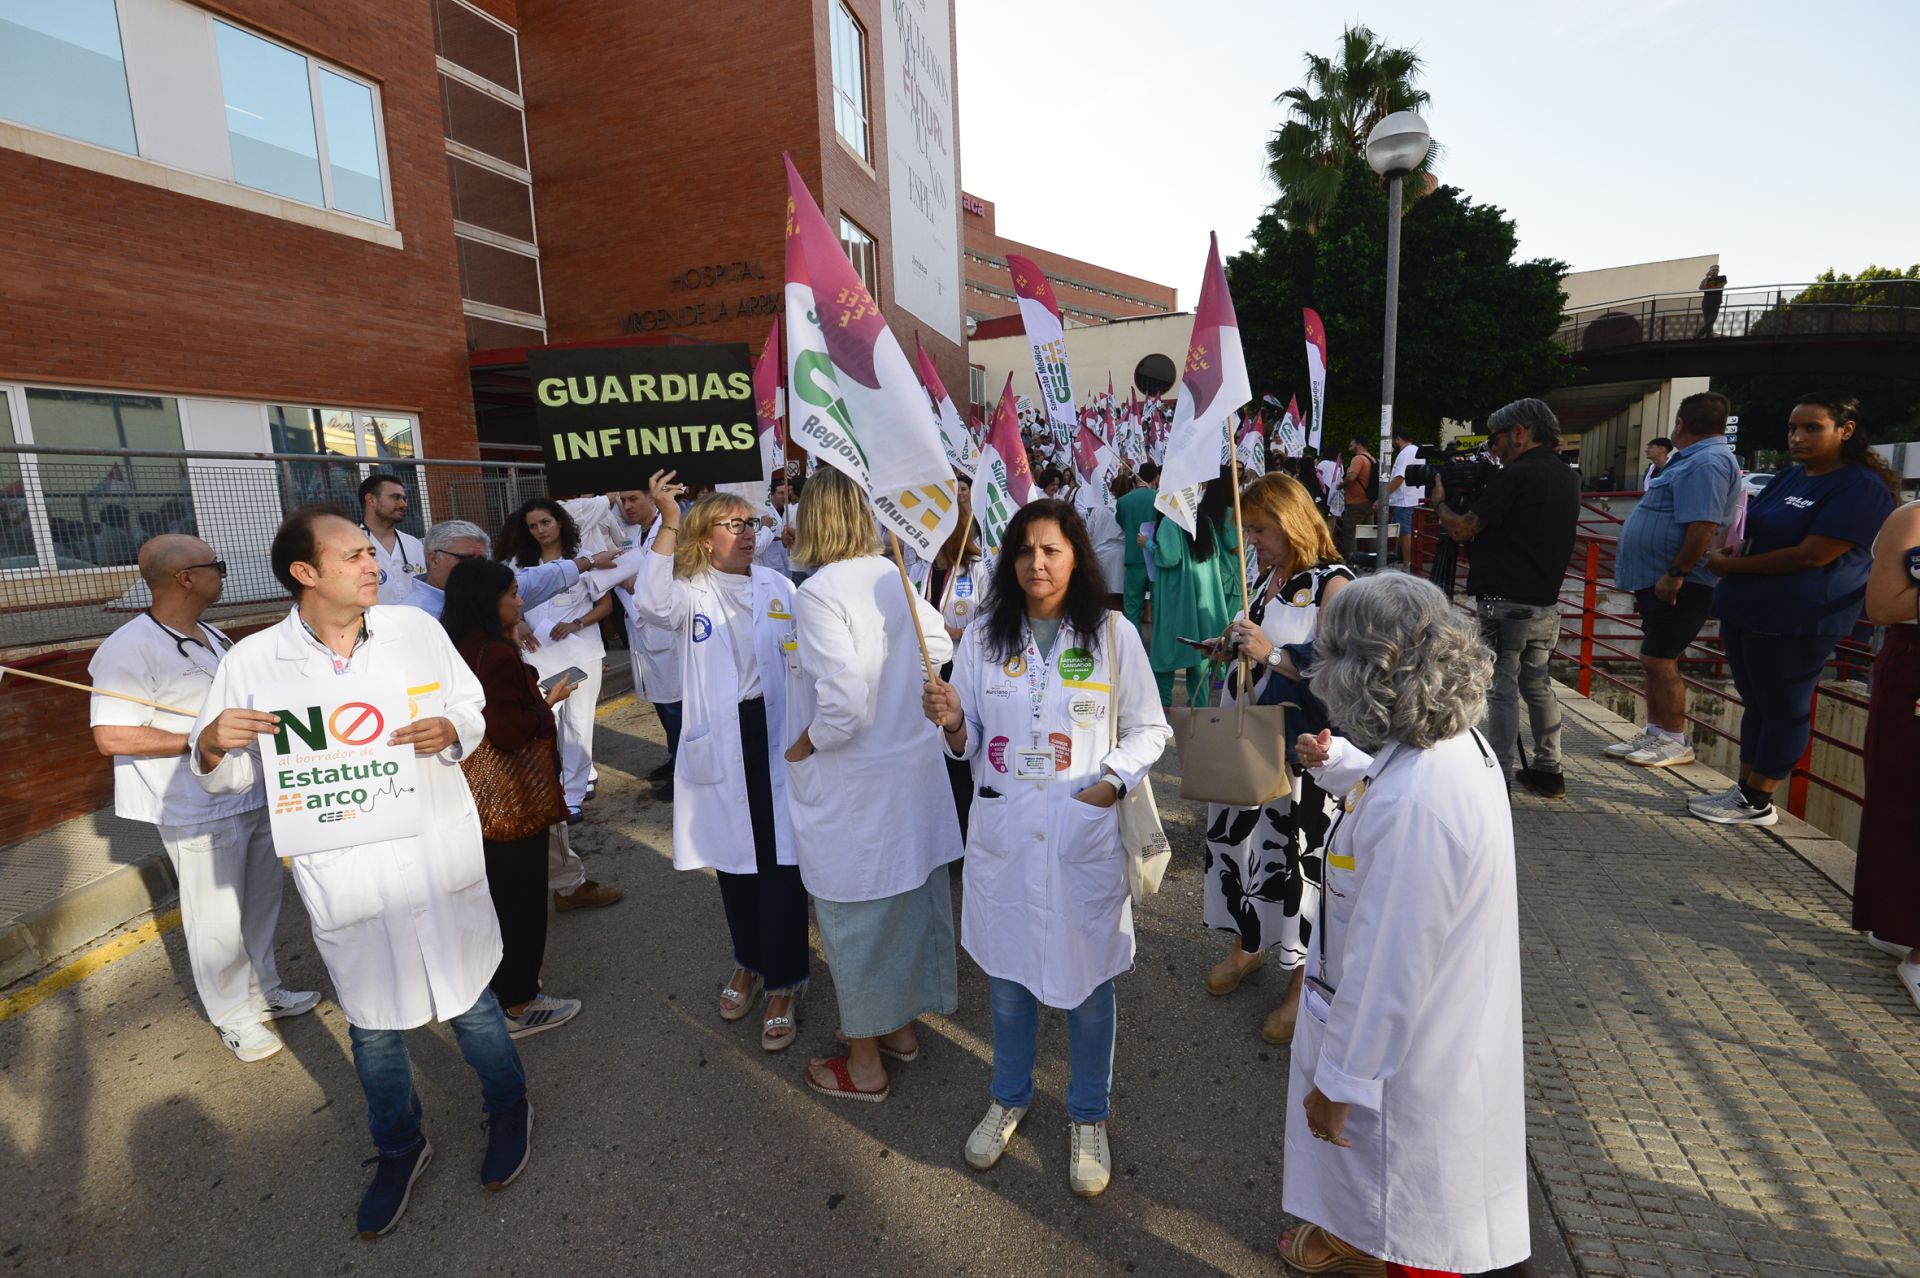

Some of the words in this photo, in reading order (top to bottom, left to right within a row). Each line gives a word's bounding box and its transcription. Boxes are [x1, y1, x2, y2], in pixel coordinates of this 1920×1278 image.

[669, 257, 765, 291] HOSPITAL
[619, 307, 682, 335] VIRGEN
[685, 303, 705, 328] DE
[710, 301, 728, 324] LA
[537, 372, 752, 407] GUARDIAS
[1041, 376, 1058, 411] Sindicato
[552, 423, 755, 461] INFINITAS
[802, 414, 861, 467] Región
[874, 495, 930, 549] Murcia
[278, 755, 290, 767] al
[295, 749, 354, 765] borrador
[359, 746, 375, 757] de
[278, 760, 399, 790] Estatuto
[275, 788, 368, 814] Marco
[318, 809, 358, 823] CESM
